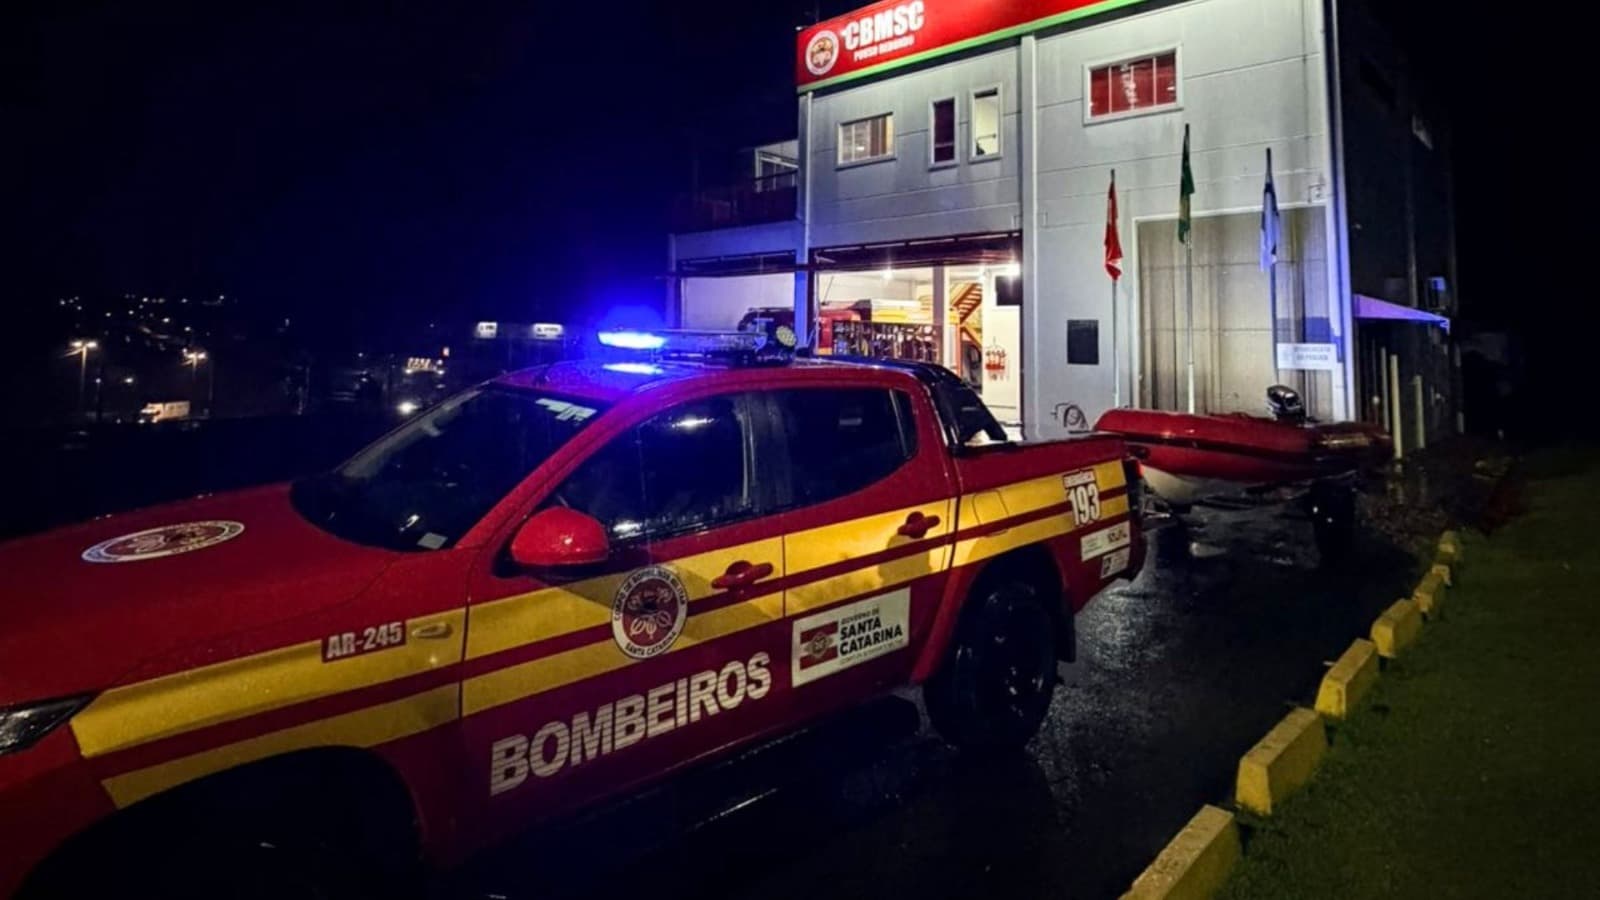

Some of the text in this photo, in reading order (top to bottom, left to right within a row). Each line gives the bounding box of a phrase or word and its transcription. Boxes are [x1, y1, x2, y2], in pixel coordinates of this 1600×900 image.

[841, 0, 924, 51] CBMSC
[1067, 483, 1100, 526] 193
[326, 621, 403, 659] AR-245
[839, 623, 903, 656] CATARINA
[840, 616, 881, 640] SANTA
[490, 652, 771, 796] BOMBEIROS
